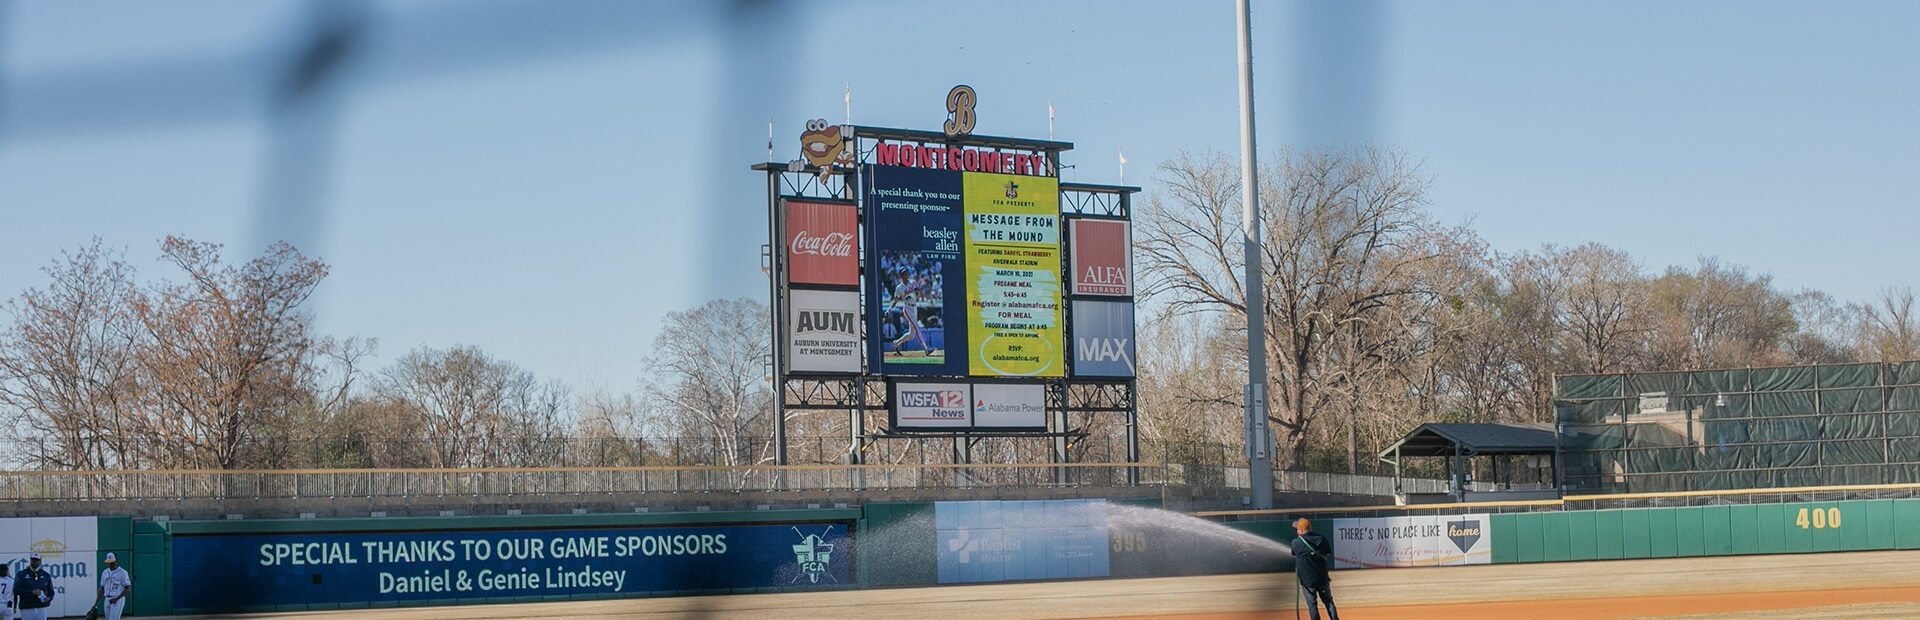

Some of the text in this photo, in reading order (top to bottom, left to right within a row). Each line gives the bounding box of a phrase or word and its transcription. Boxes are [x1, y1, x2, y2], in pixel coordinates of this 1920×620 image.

[944, 85, 977, 136] B
[876, 143, 1044, 176] MONTGOMERY
[870, 186, 876, 194] A
[878, 187, 901, 198] special
[902, 187, 924, 198] thank
[925, 191, 938, 200] you
[881, 201, 919, 212] presenting
[972, 213, 1053, 228] MESSAGE FROM
[923, 226, 958, 242] beasley
[983, 229, 1043, 242] THE MOUND
[935, 239, 958, 251] allen
[977, 248, 1052, 258] FEATURING DARRYL STRAWBERRY
[1083, 265, 1126, 284] ALFA
[1079, 286, 1125, 294] INSURANCE
[972, 300, 1001, 308] Register
[1008, 301, 1059, 310] alabamafca.org
[796, 310, 855, 336] AUM
[820, 340, 858, 348] UNIVERSITY
[809, 348, 853, 356] MONTGOMERY
[992, 354, 1040, 363] alabamafca.org
[1079, 337, 1134, 374] MAX
[902, 390, 965, 408] WSFA 12
[932, 408, 965, 418] News
[988, 403, 1044, 413] Alabama Power
[1795, 507, 1842, 529] 400
[1338, 524, 1441, 541] THERE'S NO PLACE LIKE
[1448, 524, 1480, 537] home
[1112, 529, 1146, 552] 395
[259, 533, 728, 567] SPECIAL THANKS TO OUR GAME SPONSORS
[802, 562, 825, 573] FCA
[379, 564, 627, 593] Daniel & Genie Lindsey
